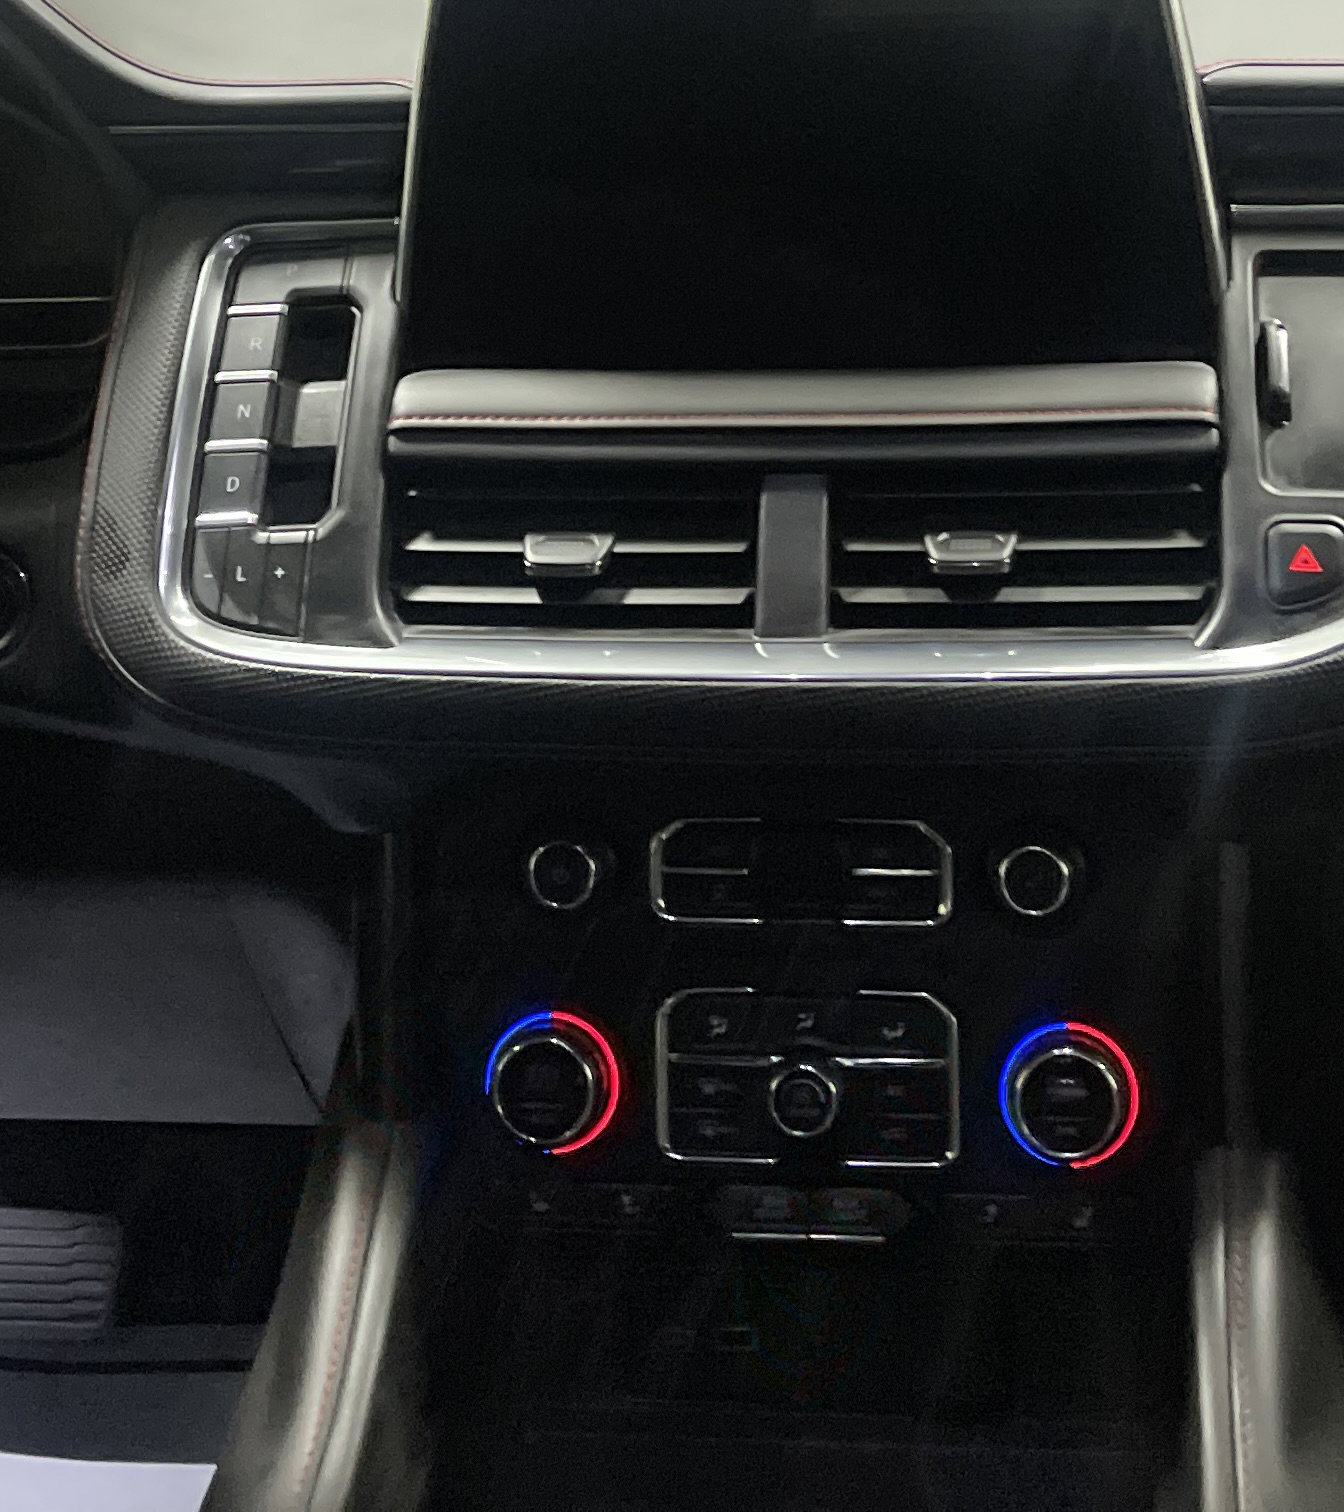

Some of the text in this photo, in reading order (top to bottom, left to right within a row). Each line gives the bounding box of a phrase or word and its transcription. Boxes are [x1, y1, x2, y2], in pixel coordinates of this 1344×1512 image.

[248, 336, 263, 351] R
[237, 404, 251, 419] N
[225, 476, 240, 493] D
[235, 566, 248, 582] L
